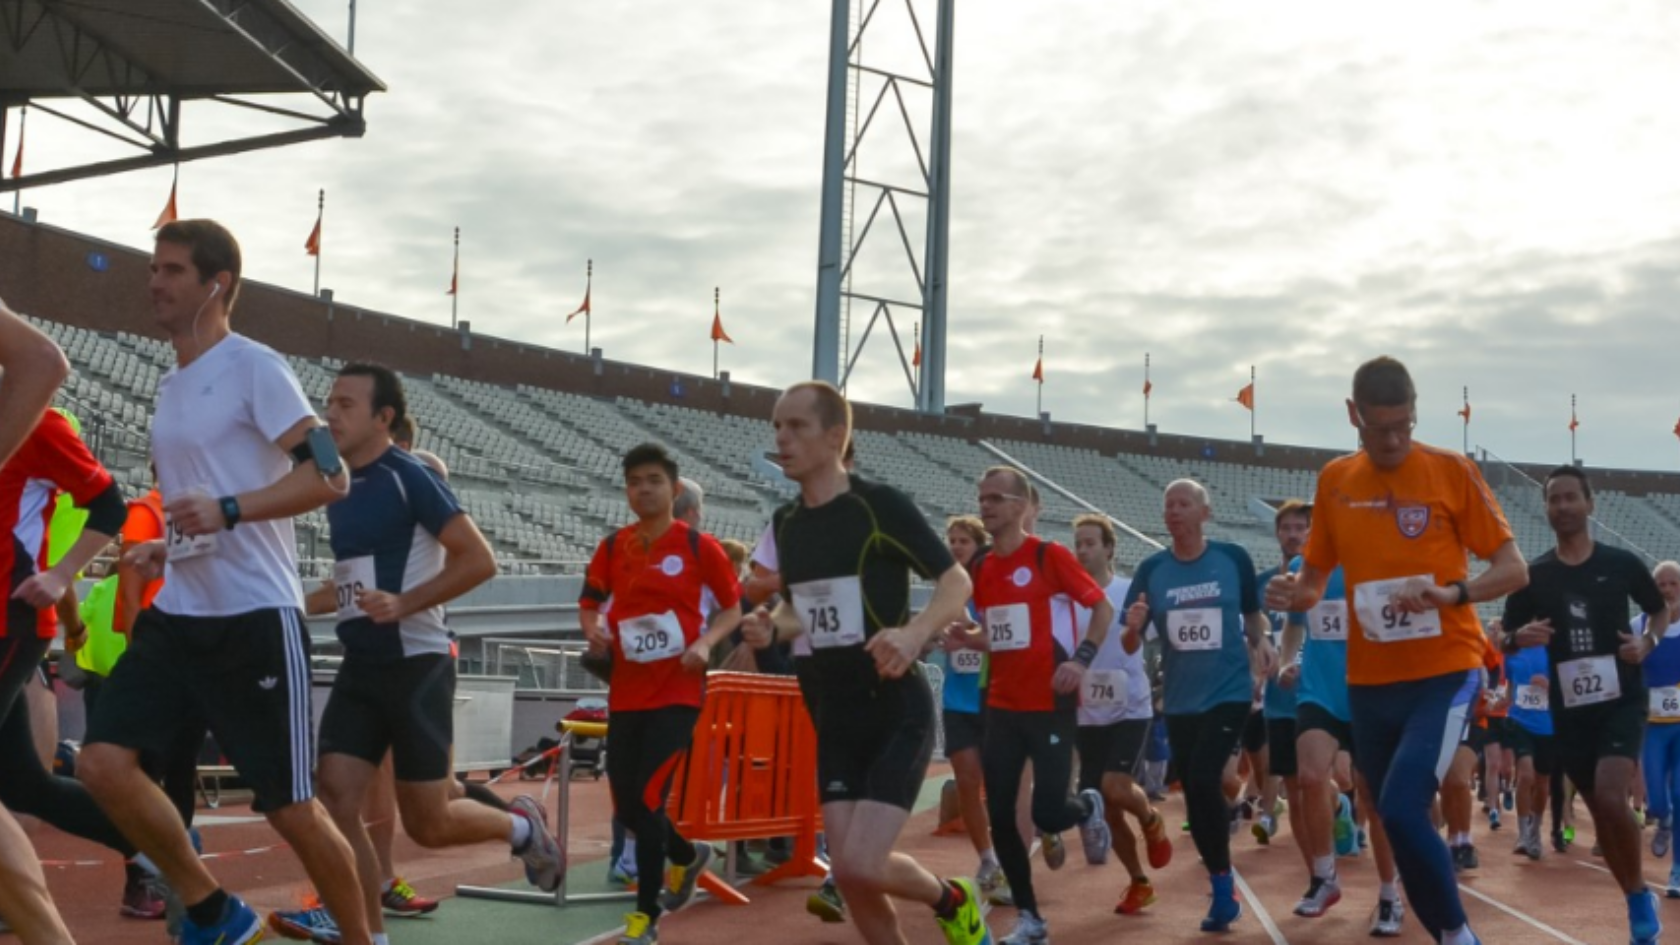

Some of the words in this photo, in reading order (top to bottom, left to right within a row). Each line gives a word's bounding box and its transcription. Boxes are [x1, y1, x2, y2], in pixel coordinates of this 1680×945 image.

[808, 605, 841, 634] 743
[1322, 616, 1341, 633] 54
[1381, 603, 1411, 629] 92
[634, 630, 668, 654] 209
[991, 623, 1013, 642] 215
[1178, 624, 1210, 642] 660
[957, 652, 980, 667] 655
[1090, 683, 1114, 700] 774
[1572, 674, 1604, 696] 622
